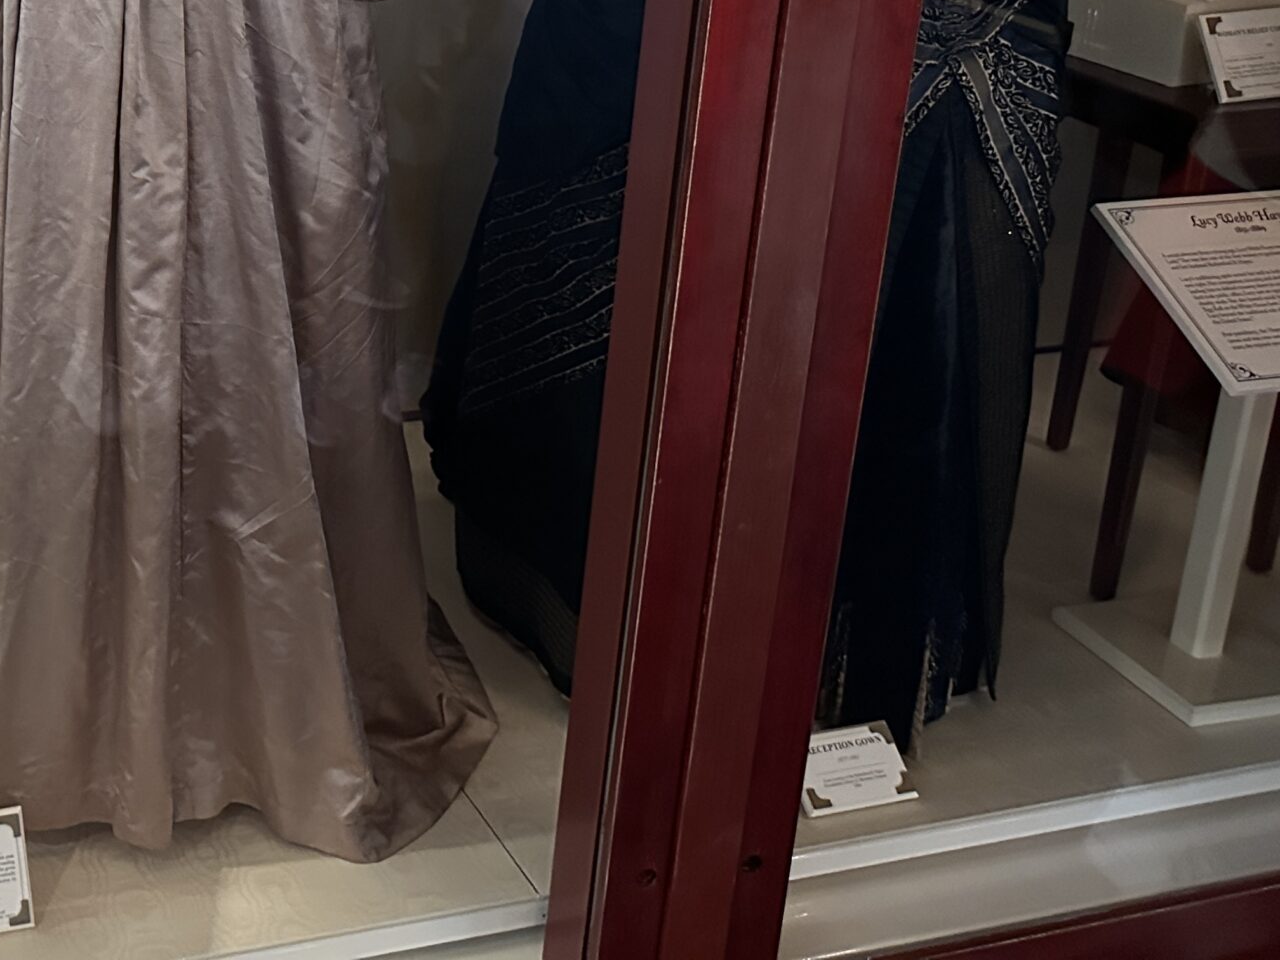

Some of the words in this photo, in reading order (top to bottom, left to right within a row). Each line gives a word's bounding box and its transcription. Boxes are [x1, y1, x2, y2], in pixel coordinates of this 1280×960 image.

[1190, 215, 1218, 229] Lucy
[1216, 211, 1253, 224] Webb
[855, 735, 882, 747] GOWN
